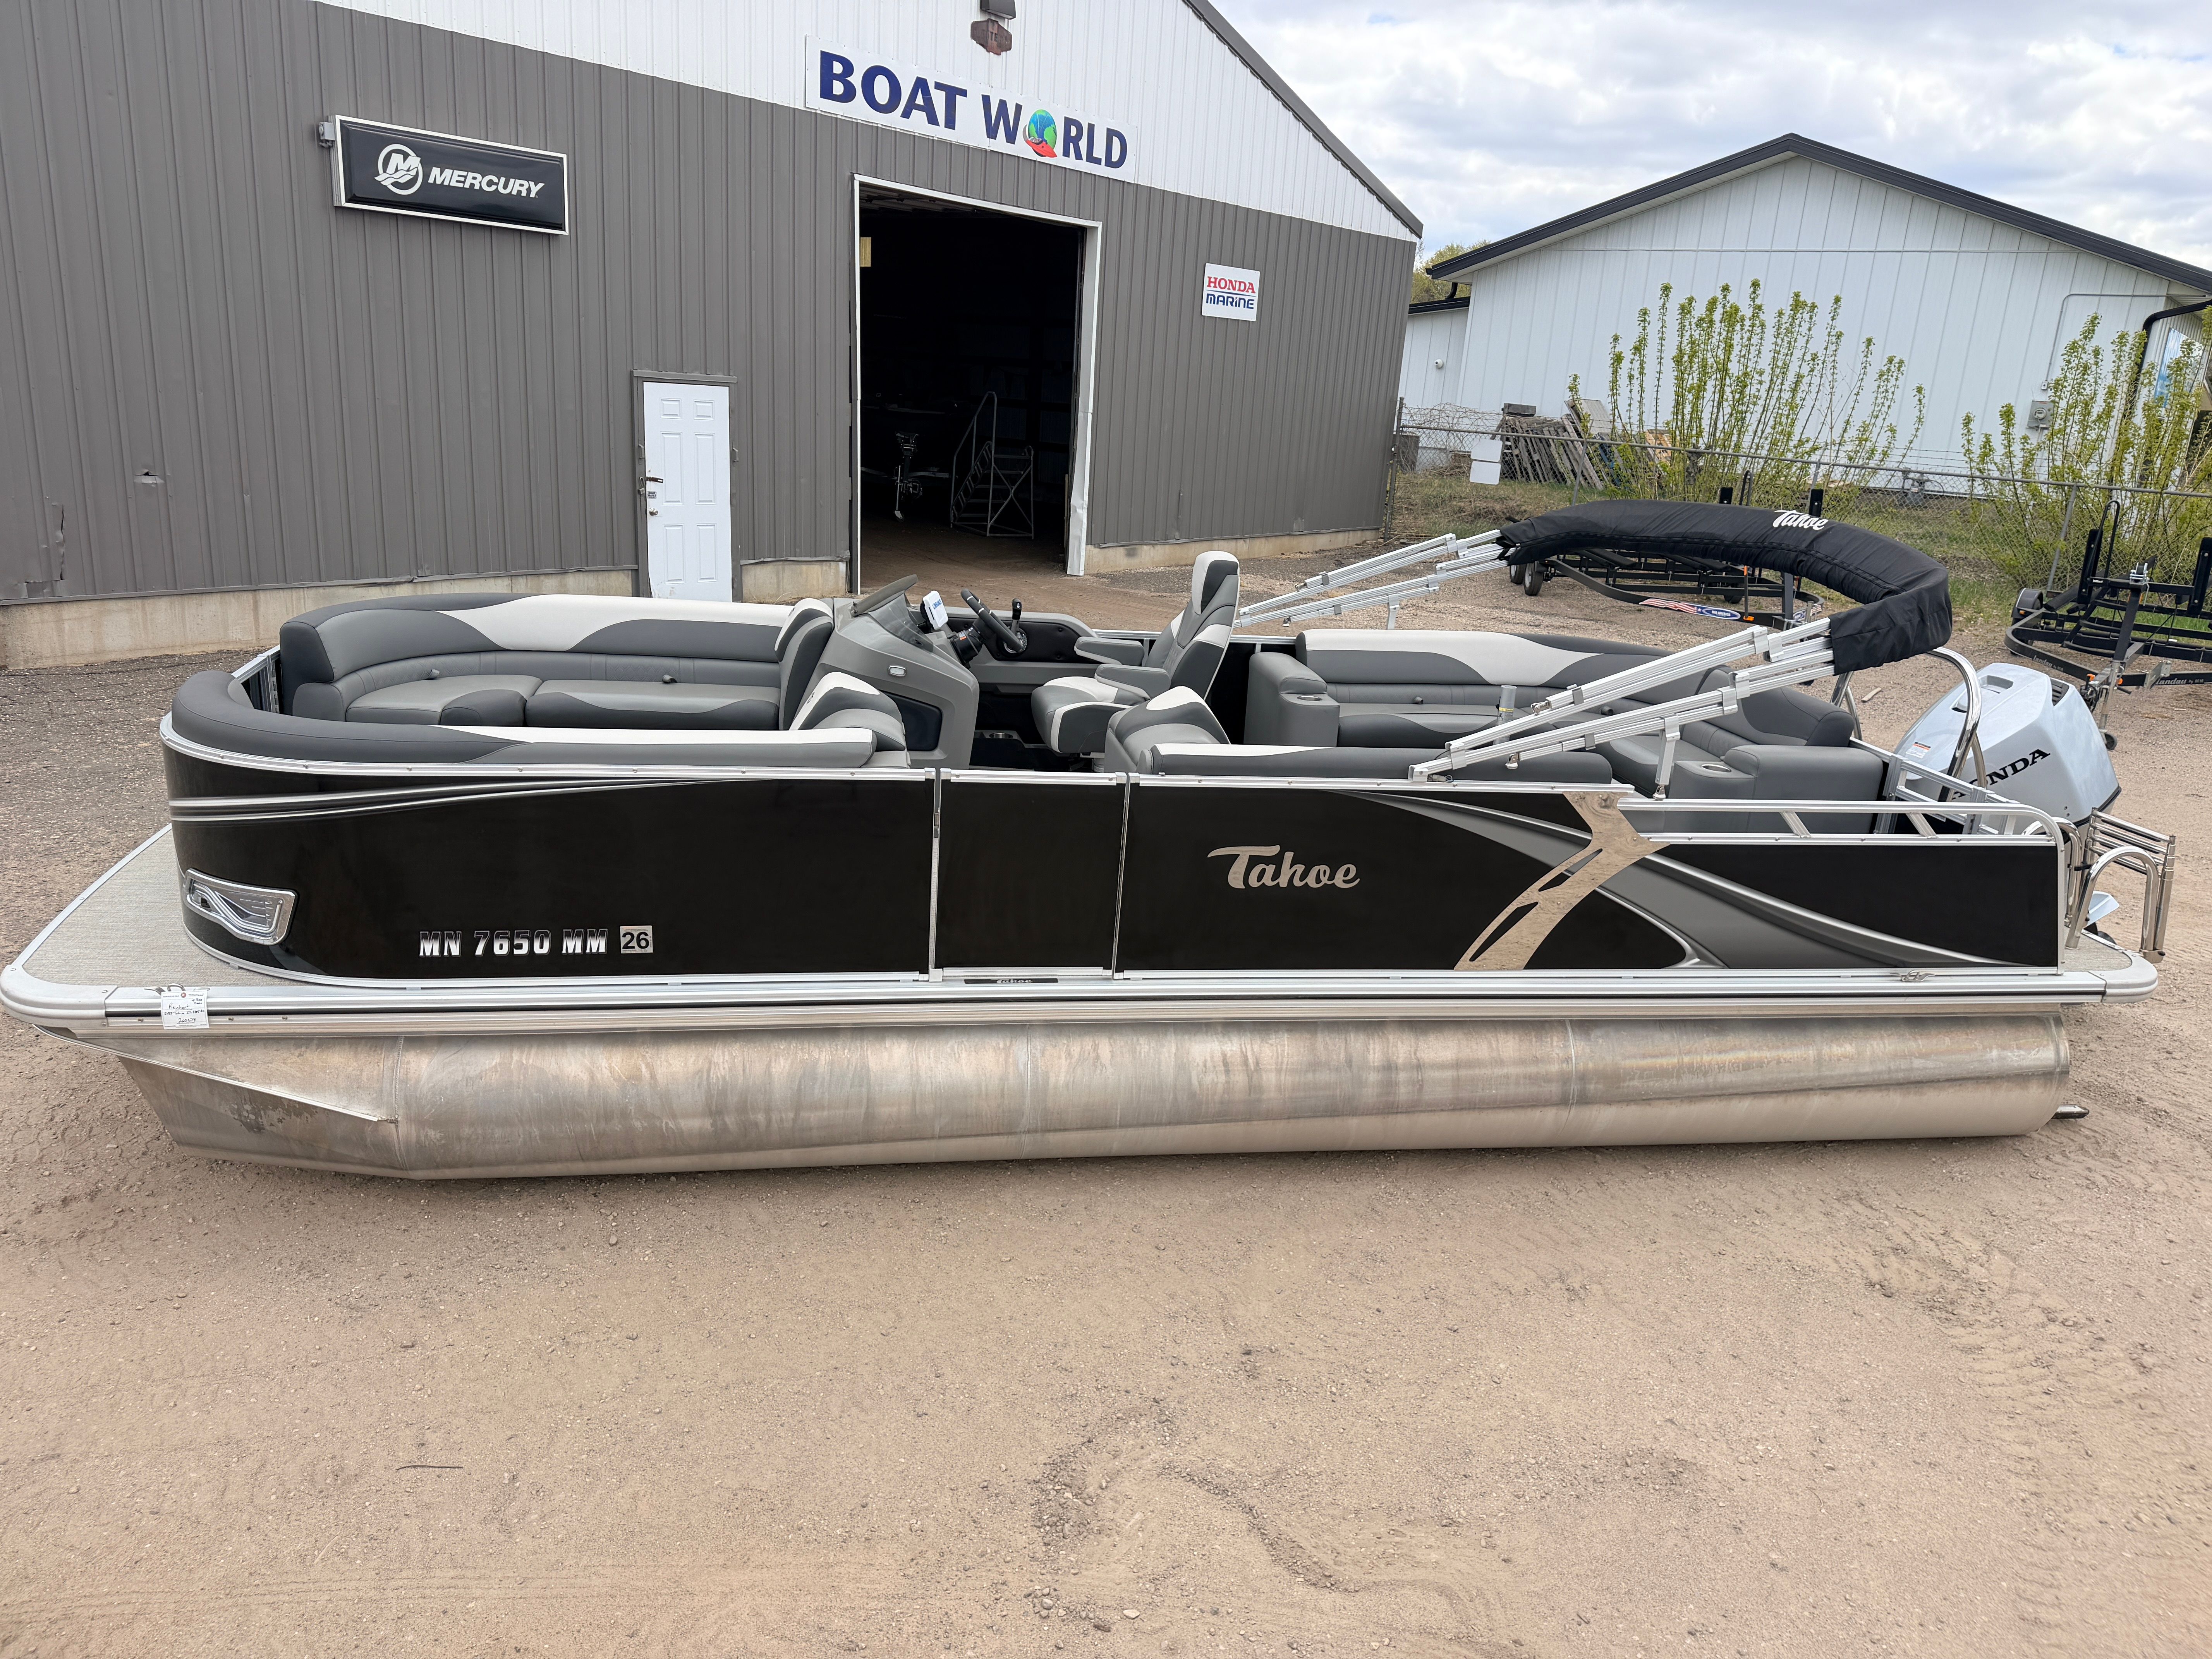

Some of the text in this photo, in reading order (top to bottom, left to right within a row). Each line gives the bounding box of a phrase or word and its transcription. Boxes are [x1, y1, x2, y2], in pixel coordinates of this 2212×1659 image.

[820, 50, 967, 131] BOAT
[428, 167, 545, 198] MERCURY
[1206, 276, 1256, 294] HONDA
[1206, 293, 1255, 309] MARINE
[1772, 510, 1829, 531] Tahoe
[1952, 749, 2051, 800] NDA
[1207, 844, 1360, 889] Tahoe
[419, 929, 608, 957] MN 7650 MM
[622, 931, 649, 949] 26
